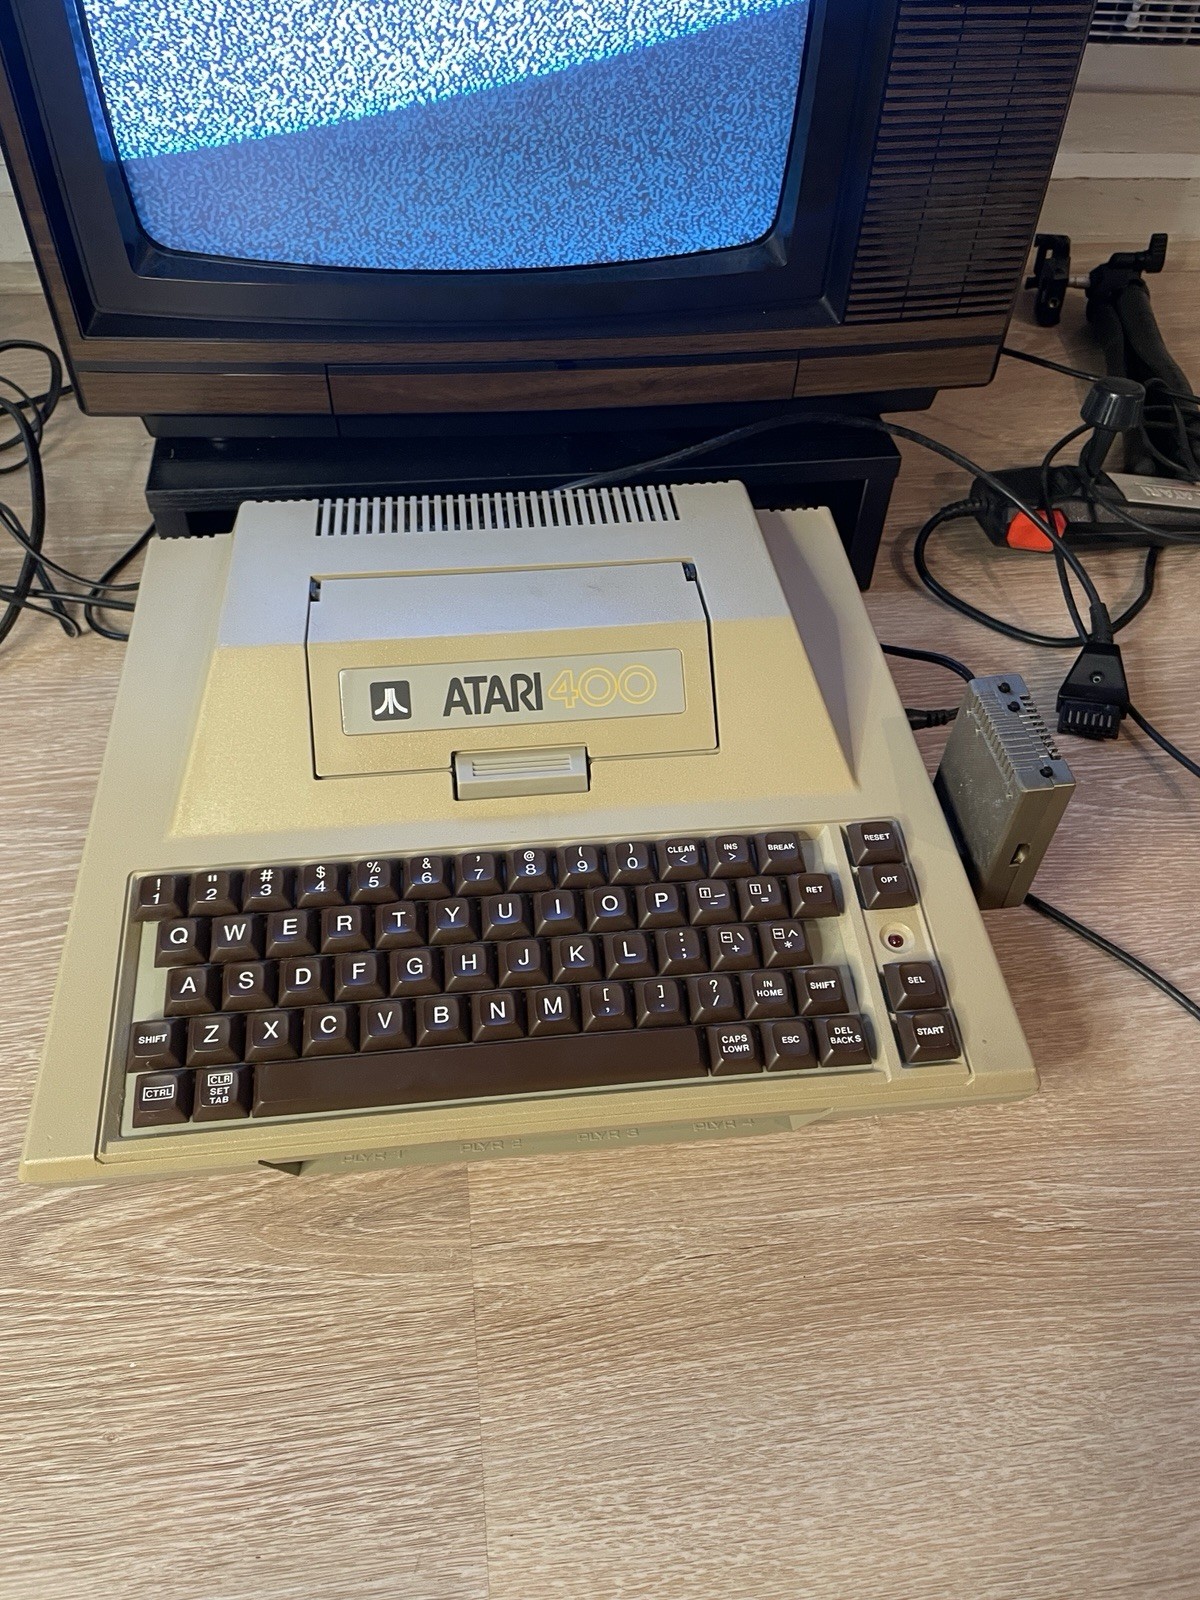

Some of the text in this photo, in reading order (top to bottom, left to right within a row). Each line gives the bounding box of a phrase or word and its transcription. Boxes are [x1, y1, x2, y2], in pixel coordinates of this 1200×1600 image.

[443, 664, 657, 717] ATARI 400
[864, 833, 890, 841] RESET
[667, 844, 696, 853] CLEAR
[723, 842, 738, 851] INS
[768, 842, 795, 851] BREAK
[525, 863, 536, 875] 8
[576, 860, 588, 872] 9
[627, 857, 638, 869] 0
[421, 872, 432, 884] 6
[474, 868, 484, 880] 7
[881, 875, 898, 884] OPT
[315, 880, 326, 892] 4
[368, 876, 379, 887] 5
[205, 888, 217, 900] 2
[260, 884, 272, 896] 3
[806, 885, 823, 894] RET
[153, 893, 160, 904] 1
[601, 895, 619, 911] O
[654, 892, 669, 908] P
[499, 902, 512, 919] U
[555, 899, 561, 914] I
[392, 911, 406, 927] T
[445, 906, 460, 923] Y
[283, 918, 298, 935] E
[336, 914, 353, 932] R
[169, 926, 189, 945] Q
[223, 923, 247, 942] W
[570, 945, 585, 962] K
[623, 941, 636, 958] L
[462, 954, 477, 970] H
[518, 949, 529, 966] J
[352, 962, 366, 980] F
[406, 958, 423, 975] G
[238, 971, 254, 989] S
[295, 967, 312, 985] D
[908, 975, 925, 984] SEL
[180, 977, 197, 994] A
[763, 980, 773, 988] IN
[810, 981, 836, 990] SHIFT
[756, 988, 783, 997] HOME
[490, 1001, 505, 1019] N
[544, 997, 563, 1014] M
[378, 1011, 393, 1029] V
[433, 1007, 449, 1024] B
[263, 1021, 279, 1040] X
[320, 1015, 337, 1034] C
[204, 1025, 219, 1043] Z
[835, 1027, 853, 1035] DEL
[917, 1026, 944, 1036] START
[138, 1034, 167, 1044] SHIFT
[722, 1035, 747, 1044] CAPS
[782, 1035, 800, 1044] ESC
[723, 1044, 750, 1053] LOWR
[211, 1075, 230, 1084] CLR
[146, 1088, 172, 1098] CTRL
[210, 1087, 229, 1095] SET
[209, 1096, 229, 1104] TAB
